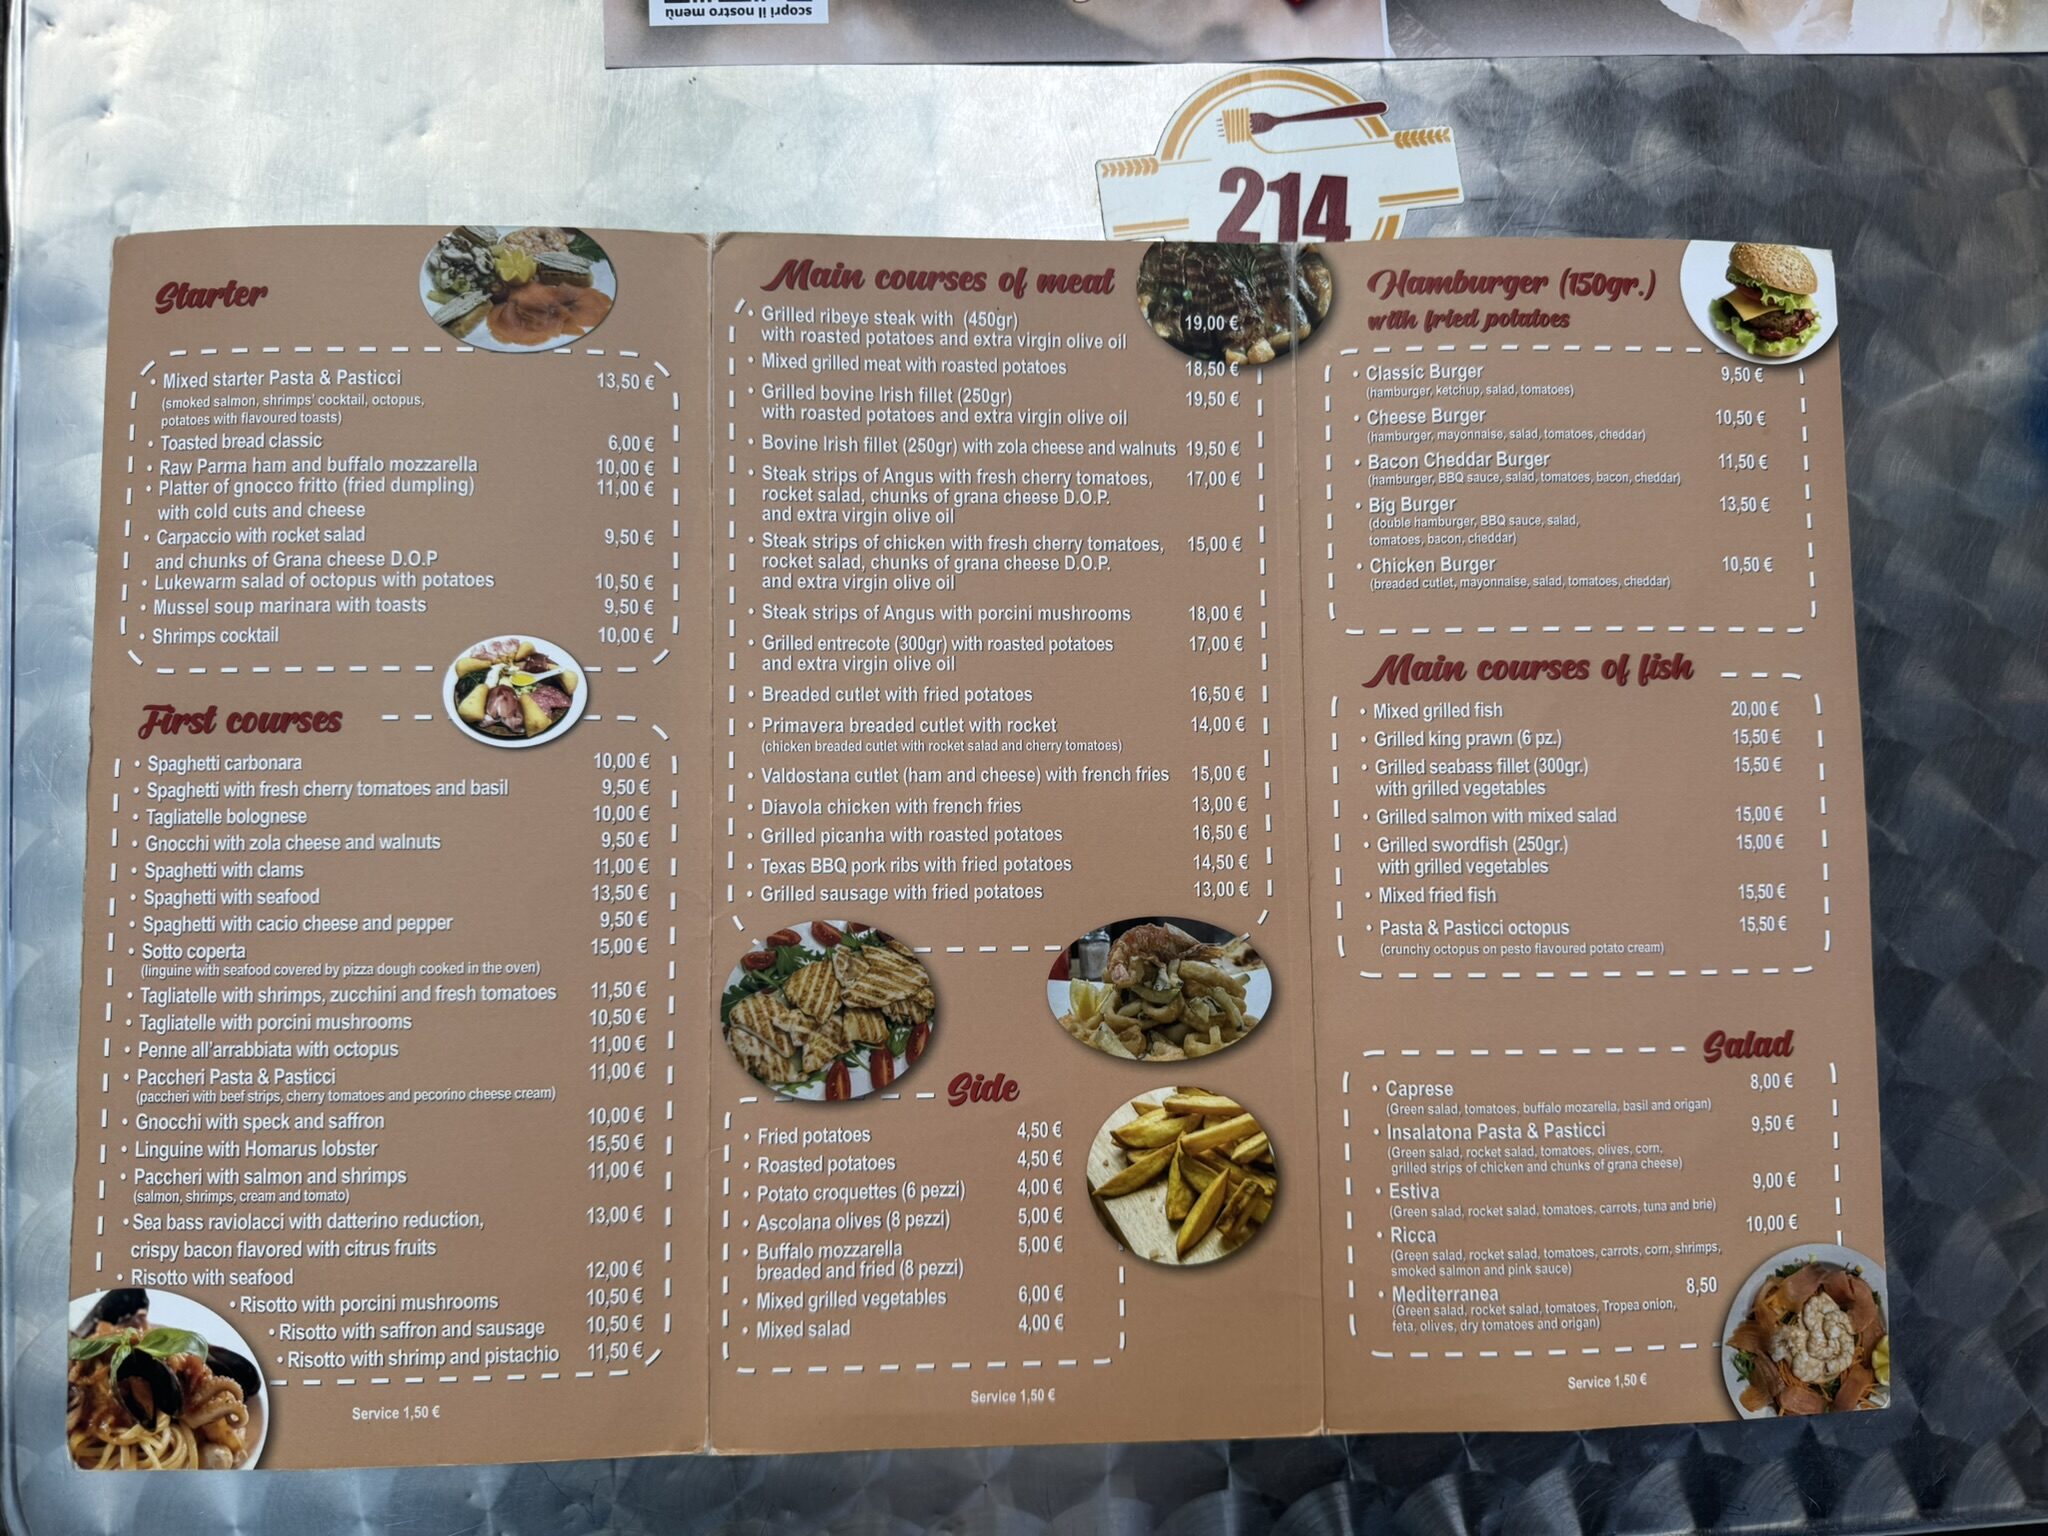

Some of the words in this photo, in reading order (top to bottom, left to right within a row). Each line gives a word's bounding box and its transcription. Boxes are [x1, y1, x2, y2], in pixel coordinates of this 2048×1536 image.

[665, 7, 705, 20] menù
[710, 7, 754, 17] nostro
[759, 7, 767, 18] il
[771, 6, 812, 18] scopri
[1217, 166, 1351, 243] 214
[760, 259, 865, 291] Main
[875, 270, 987, 292] courses
[999, 267, 1028, 299] of
[1037, 268, 1115, 294] meat
[1367, 269, 1549, 300] Hamburger
[1560, 268, 1656, 302] (150gr.)
[155, 280, 268, 314] Starter
[1186, 316, 1224, 330] 19,00
[1230, 316, 1238, 330] €
[1368, 310, 1418, 330] with
[1424, 309, 1479, 333] fried
[1480, 308, 1570, 333] potatoes
[762, 352, 807, 369] Mixed
[812, 354, 859, 373] grilled
[864, 357, 901, 372] meat
[905, 356, 936, 372] with
[942, 357, 997, 373] roasted
[1003, 359, 1066, 377] potatoes
[1186, 361, 1224, 378] 18,50
[1230, 362, 1238, 376] €
[1366, 364, 1424, 381] Classic
[1430, 363, 1483, 382] Burger
[163, 372, 207, 388] Mixed
[213, 372, 264, 387] starter
[269, 369, 313, 385] Pasta
[319, 369, 331, 385] &
[337, 369, 400, 385] Pasticci
[597, 372, 639, 391] 13,50
[644, 374, 654, 390] €
[1721, 366, 1750, 383] 9,50
[1754, 368, 1763, 382] €
[1367, 386, 1432, 400] (hamburger,
[1436, 384, 1483, 397] ketchup,
[1486, 384, 1518, 395] salad,
[1521, 384, 1573, 396] tomatoes)
[162, 396, 210, 412] (smoked
[214, 395, 258, 407] salmon,
[318, 393, 368, 406] cocktail,
[372, 394, 424, 407] octopus,
[161, 415, 210, 429] potatoes
[214, 413, 237, 424] with
[241, 411, 296, 423] flavoured
[300, 411, 341, 425] toasts)
[160, 433, 217, 450] Toasted
[222, 432, 264, 448] bread
[269, 432, 322, 448] classic
[608, 435, 640, 453] 6,00
[644, 436, 654, 452] €
[1369, 497, 1395, 516] Big
[1401, 496, 1456, 514] Burger
[1720, 496, 1756, 513] 13,50
[1761, 497, 1770, 512] €
[152, 628, 215, 647] Shrimps
[220, 626, 278, 643] cocktail
[598, 627, 639, 645] 10,00
[643, 628, 653, 643] €
[1362, 653, 1467, 688] Main
[1477, 659, 1590, 681] courses
[1601, 654, 1630, 686] of
[1638, 653, 1694, 687] fish
[763, 686, 829, 702] Breaded
[835, 686, 880, 702] cutlet
[885, 686, 917, 701] with
[923, 686, 958, 701] fried
[965, 687, 1032, 705] potatoes
[1191, 686, 1230, 704] 16,50
[1235, 686, 1244, 701] €
[1374, 703, 1418, 719] Mixed
[1423, 702, 1470, 722] grilled
[1474, 702, 1502, 717] fish
[1731, 701, 1767, 718] 20,00
[1770, 701, 1779, 716] €
[138, 704, 217, 740] First
[226, 711, 343, 733] courses
[762, 740, 810, 755] (chicken
[815, 740, 862, 752] breaded
[865, 740, 897, 751] cutlet
[901, 740, 924, 751] with
[929, 740, 964, 751] rocket
[967, 740, 998, 751] salad
[1002, 740, 1022, 751] and
[1026, 740, 1062, 753] cherry
[1065, 739, 1121, 753] tomatoes)
[148, 755, 220, 775] Spaghetti
[224, 754, 302, 770] carbonara
[594, 752, 635, 771] 10,00
[639, 753, 649, 768] €
[146, 808, 222, 828] Tagliatelle
[226, 808, 307, 827] bolognese
[593, 805, 635, 824] 10,00
[639, 805, 649, 821] €
[1379, 887, 1424, 902] Mixed
[1428, 887, 1463, 902] fried
[1467, 886, 1496, 902] fish
[1738, 883, 1773, 901] 15,50
[1777, 883, 1786, 898] €
[142, 943, 182, 959] Sotto
[187, 944, 245, 962] coperta
[591, 938, 633, 957] 15,00
[636, 937, 647, 953] €
[1704, 1030, 1794, 1063] Salad
[948, 1072, 1020, 1107] Side
[1386, 1080, 1454, 1100] Caprese
[1751, 1073, 1780, 1091] 8,00
[1784, 1072, 1793, 1088] €
[1387, 1103, 1424, 1116] (Green
[1428, 1103, 1461, 1115] salad,
[1464, 1104, 1519, 1114] tomatoes,
[1523, 1102, 1561, 1114] buffalo
[1565, 1101, 1620, 1112] mozarella,
[1623, 1099, 1648, 1111] basil
[1651, 1099, 1671, 1110] and
[1674, 1098, 1711, 1112] origan)
[758, 1127, 797, 1145] Fried
[803, 1128, 870, 1147] potatoes
[1017, 1121, 1048, 1141] 4,50
[1052, 1121, 1061, 1138] €
[758, 1155, 822, 1173] Roasted
[828, 1155, 895, 1176] potatoes
[1017, 1150, 1048, 1169] 4,50
[1052, 1149, 1062, 1166] €
[1753, 1172, 1783, 1191] 9,00
[1787, 1171, 1796, 1187] €
[133, 1190, 182, 1205] (salmon,
[186, 1190, 236, 1205] shrimps,
[239, 1192, 275, 1202] cream
[279, 1189, 300, 1201] and
[303, 1189, 349, 1204] tomato)
[1390, 1182, 1439, 1200] Estiva
[1746, 1215, 1784, 1233] 10,00
[1788, 1214, 1797, 1229] €
[1391, 1226, 1436, 1244] Ricca
[131, 1269, 187, 1286] Risotto
[192, 1269, 224, 1285] with
[229, 1268, 293, 1285] seafood
[586, 1260, 628, 1280] 12,00
[632, 1260, 642, 1277] €
[1393, 1286, 1498, 1303] Mediterranea
[1686, 1276, 1717, 1296] 8,50
[757, 1320, 803, 1339] Mixed
[808, 1319, 850, 1339] salad
[1018, 1314, 1050, 1334] 4,00
[1054, 1313, 1063, 1332] €
[1568, 1376, 1611, 1390] Service
[1614, 1374, 1637, 1388] 1,50
[1640, 1373, 1647, 1385] €
[971, 1390, 1016, 1404] Service
[1020, 1388, 1044, 1404] 1,50
[1048, 1388, 1055, 1402] €
[352, 1407, 399, 1420] Service
[403, 1406, 429, 1420] 1,50
[432, 1405, 440, 1418] €
